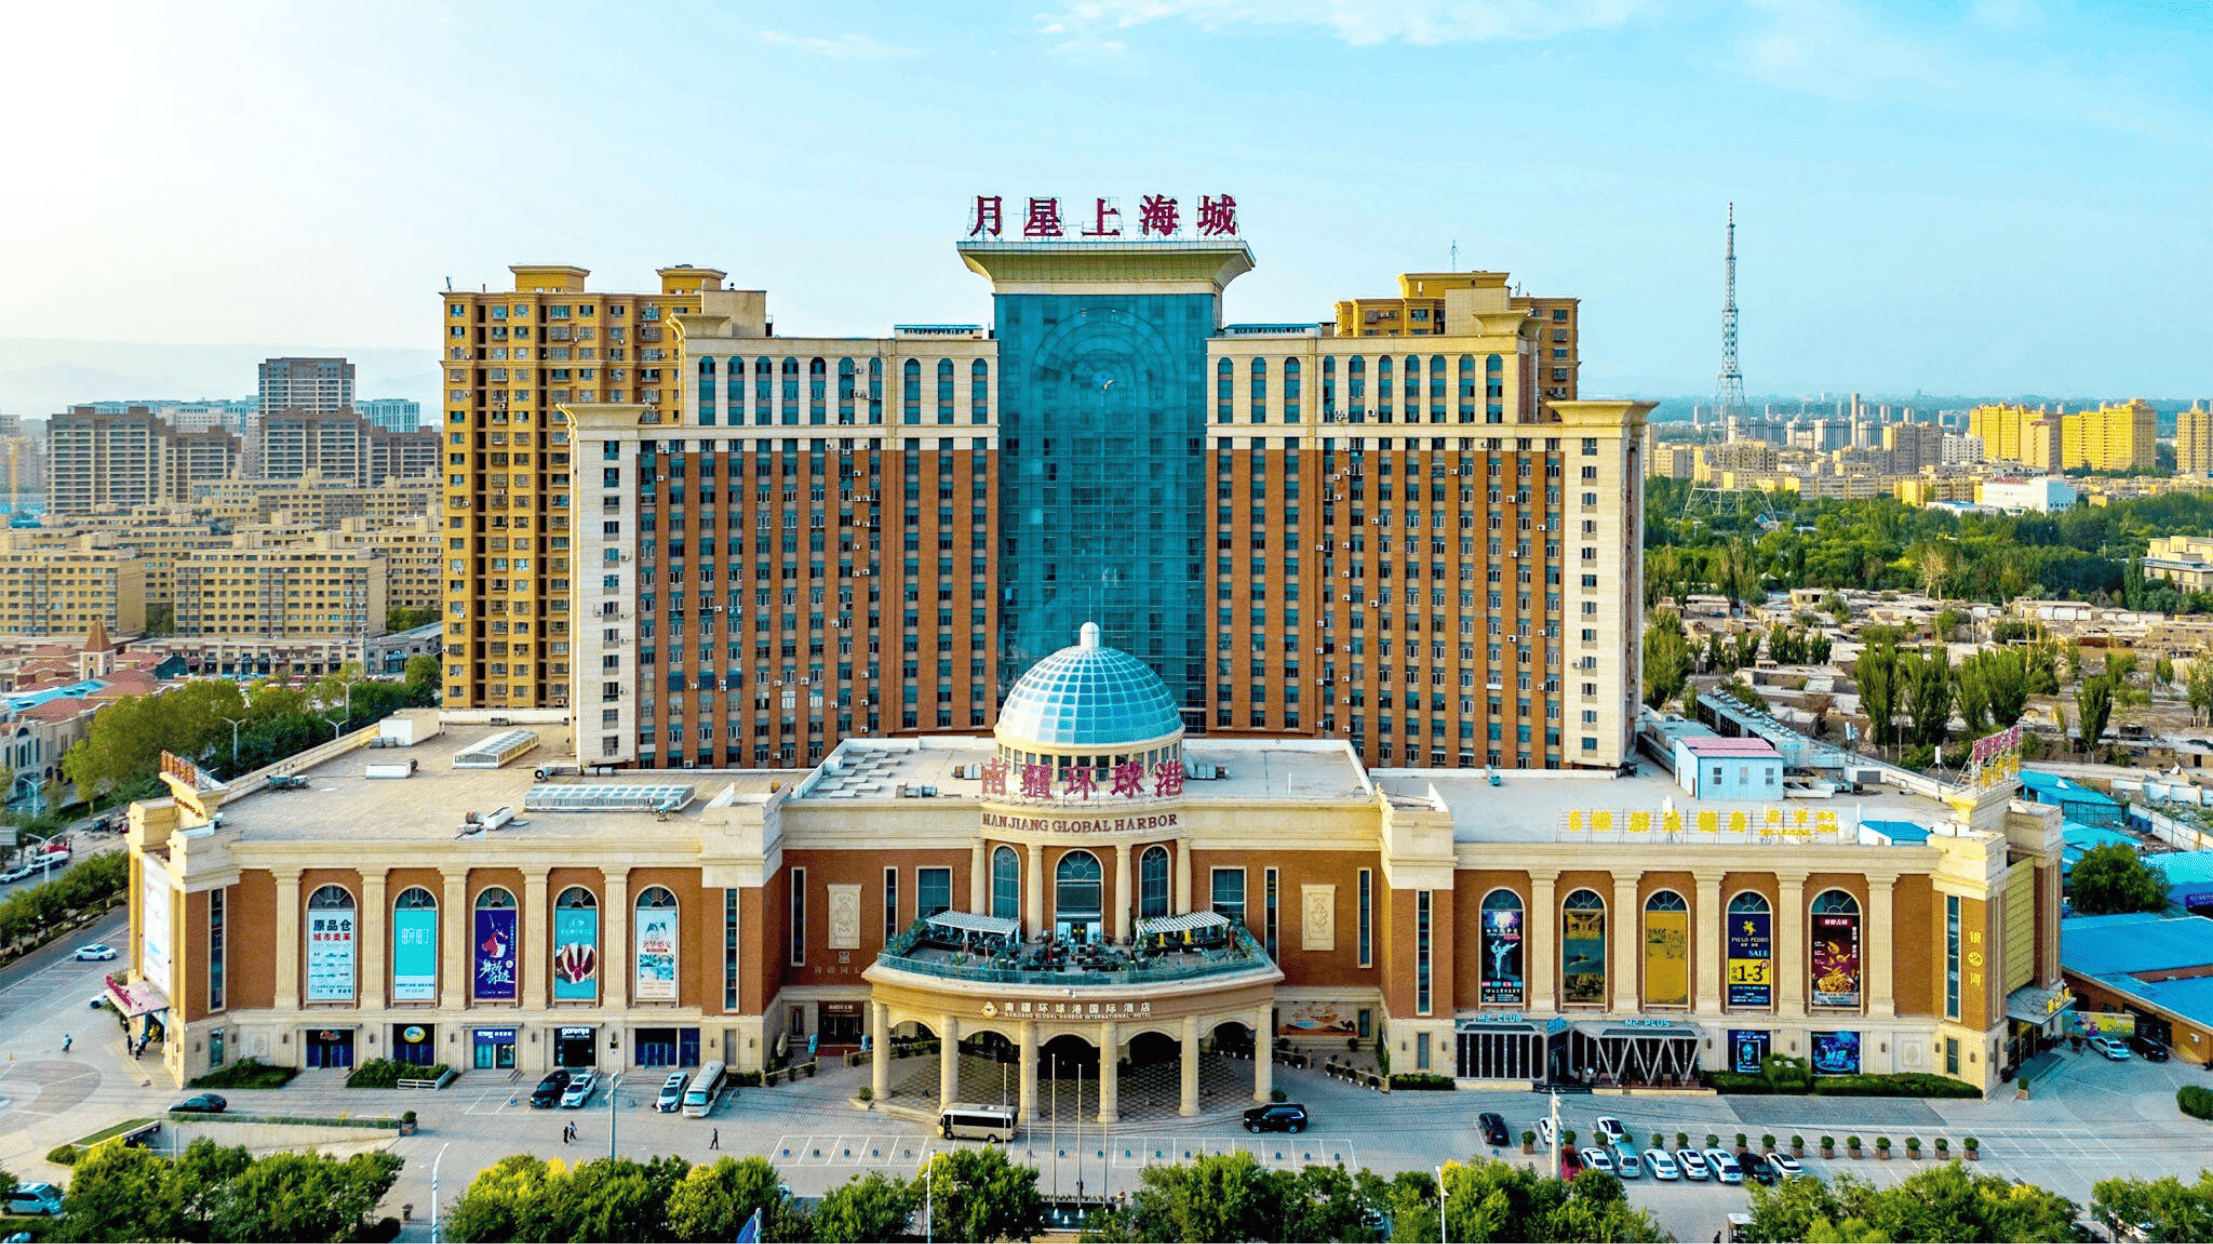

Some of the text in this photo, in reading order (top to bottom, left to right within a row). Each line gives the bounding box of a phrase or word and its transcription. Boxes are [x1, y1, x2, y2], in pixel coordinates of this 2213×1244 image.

[970, 194, 1237, 237] 月星上海城
[981, 758, 1184, 800] 南疆环球港
[1052, 819, 1111, 833] GLOBAL
[1114, 813, 1178, 832] HARBOR
[313, 919, 351, 931] 原品仓
[1738, 965, 1763, 982] 1-3
[1497, 1014, 1522, 1022] CLUB
[1645, 1019, 1670, 1027] PLUS
